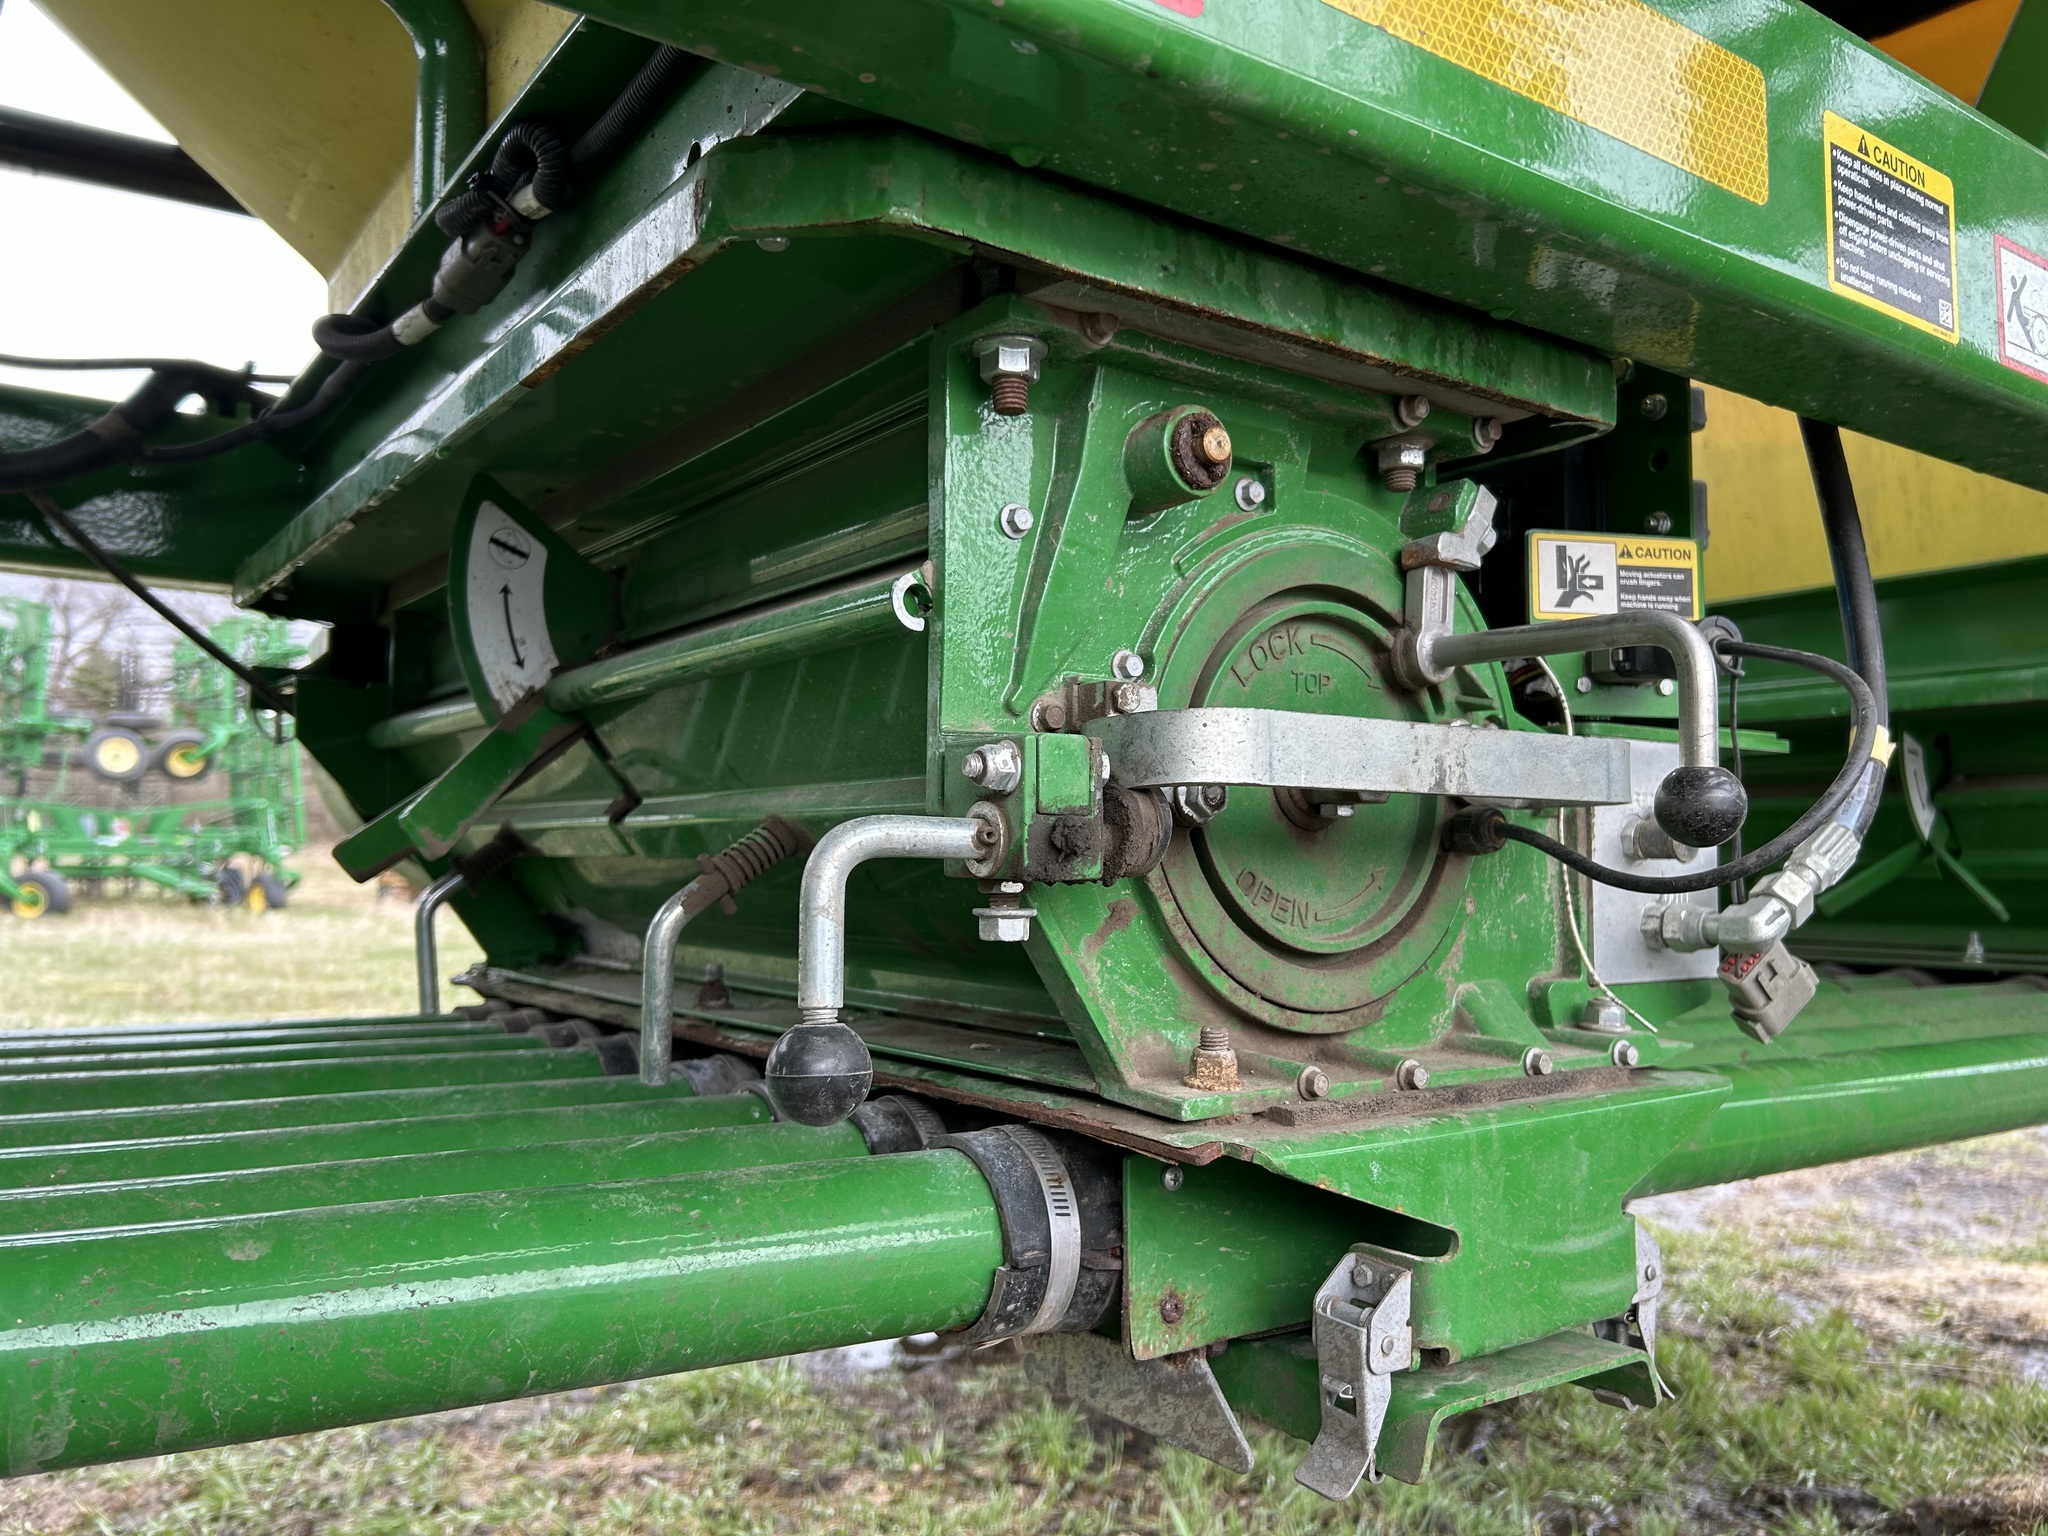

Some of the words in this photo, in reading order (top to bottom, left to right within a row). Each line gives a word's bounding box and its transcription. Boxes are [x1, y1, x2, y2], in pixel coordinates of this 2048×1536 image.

[1836, 164, 1870, 188] operations.
[1873, 146, 1925, 188] CAUTION
[1836, 149, 1852, 168] Keep
[1861, 164, 1882, 182] shields
[1883, 174, 1889, 186] in
[1890, 179, 1905, 194] place
[1906, 187, 1924, 207] during
[1924, 198, 1943, 215] normal
[1837, 179, 1853, 198] Keep
[1854, 188, 1874, 208] hands,
[1874, 198, 1886, 213] feet
[1886, 207, 1897, 219] and
[1898, 212, 1921, 233] clothing
[1921, 225, 1935, 240] away
[1837, 194, 1876, 221] power-driven
[1877, 214, 1894, 229] parts.
[1838, 210, 1869, 236] Disengage
[1870, 228, 1906, 252] power-driven
[1907, 246, 1921, 260] parts
[1922, 253, 1932, 265] and
[1933, 259, 1945, 272] shut
[1839, 238, 1866, 258] machine.
[1838, 225, 1847, 236] off
[1848, 230, 1868, 246] engine
[1869, 237, 1887, 255] before
[1888, 249, 1919, 273] unclogging
[1926, 268, 1950, 288] servicing
[1839, 257, 1848, 270] Do
[1849, 263, 1859, 275] not
[1860, 266, 1875, 282] leave
[1876, 275, 1897, 295] running
[1898, 286, 1921, 303] machine
[1840, 272, 1874, 294] unattended.
[1635, 547, 1691, 561] CAUTION
[1619, 570, 1642, 578] Moving
[1643, 571, 1672, 580] actuators
[1620, 578, 1638, 586] crush
[1620, 592, 1636, 602] Keep
[1637, 593, 1657, 602] hands
[1674, 595, 1691, 603] when
[1620, 601, 1647, 609] machine
[1654, 602, 1679, 611] running
[1230, 626, 1305, 688] LOCK
[1290, 670, 1331, 694] TOP
[1235, 867, 1310, 929] OPEN
